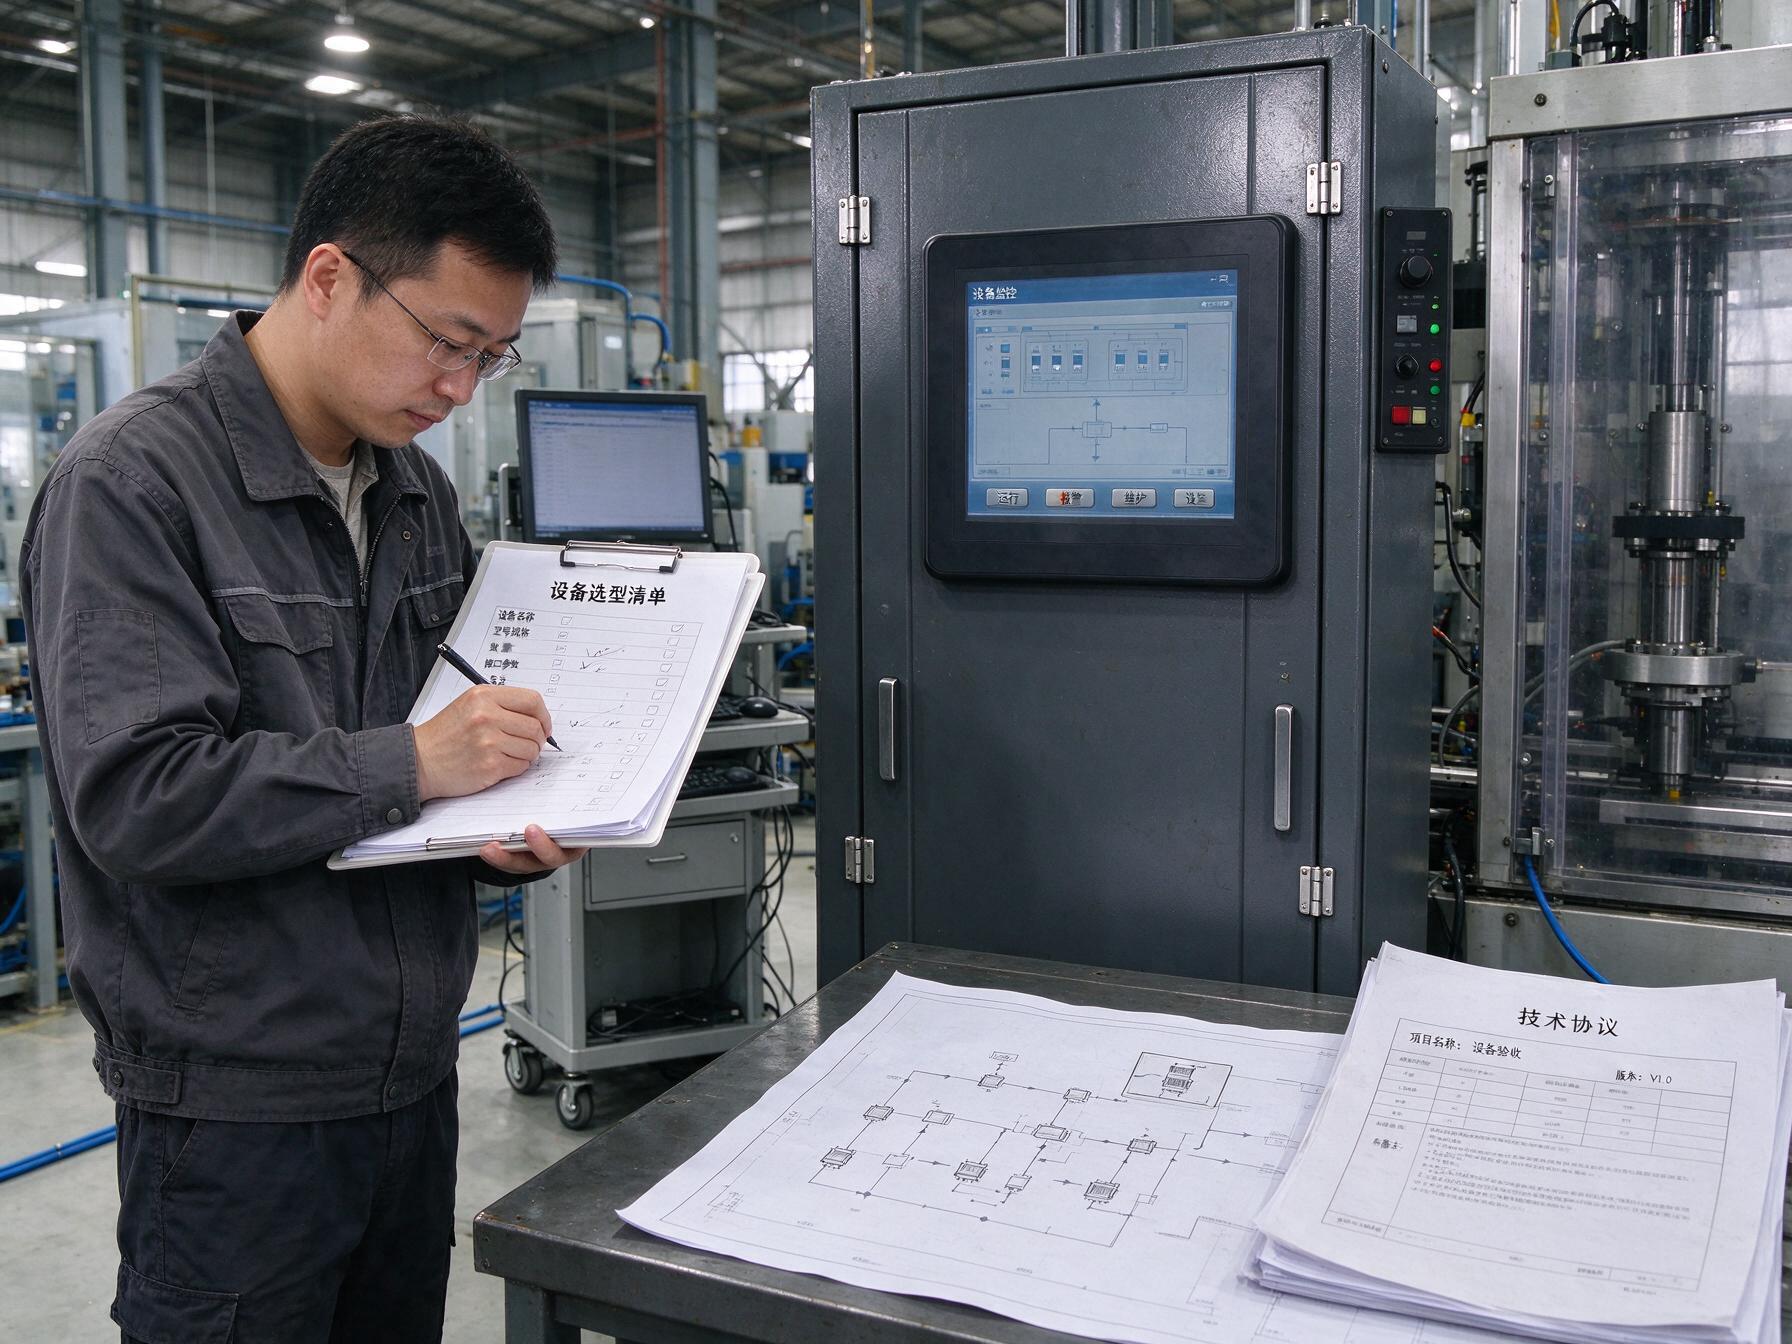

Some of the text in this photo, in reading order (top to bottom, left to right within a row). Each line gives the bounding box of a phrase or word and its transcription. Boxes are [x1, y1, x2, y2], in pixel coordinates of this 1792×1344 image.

[550, 580, 666, 605] 设备选型清单
[1517, 1006, 1620, 1037] 技术协议
[1650, 1073, 1672, 1085] V1.0
